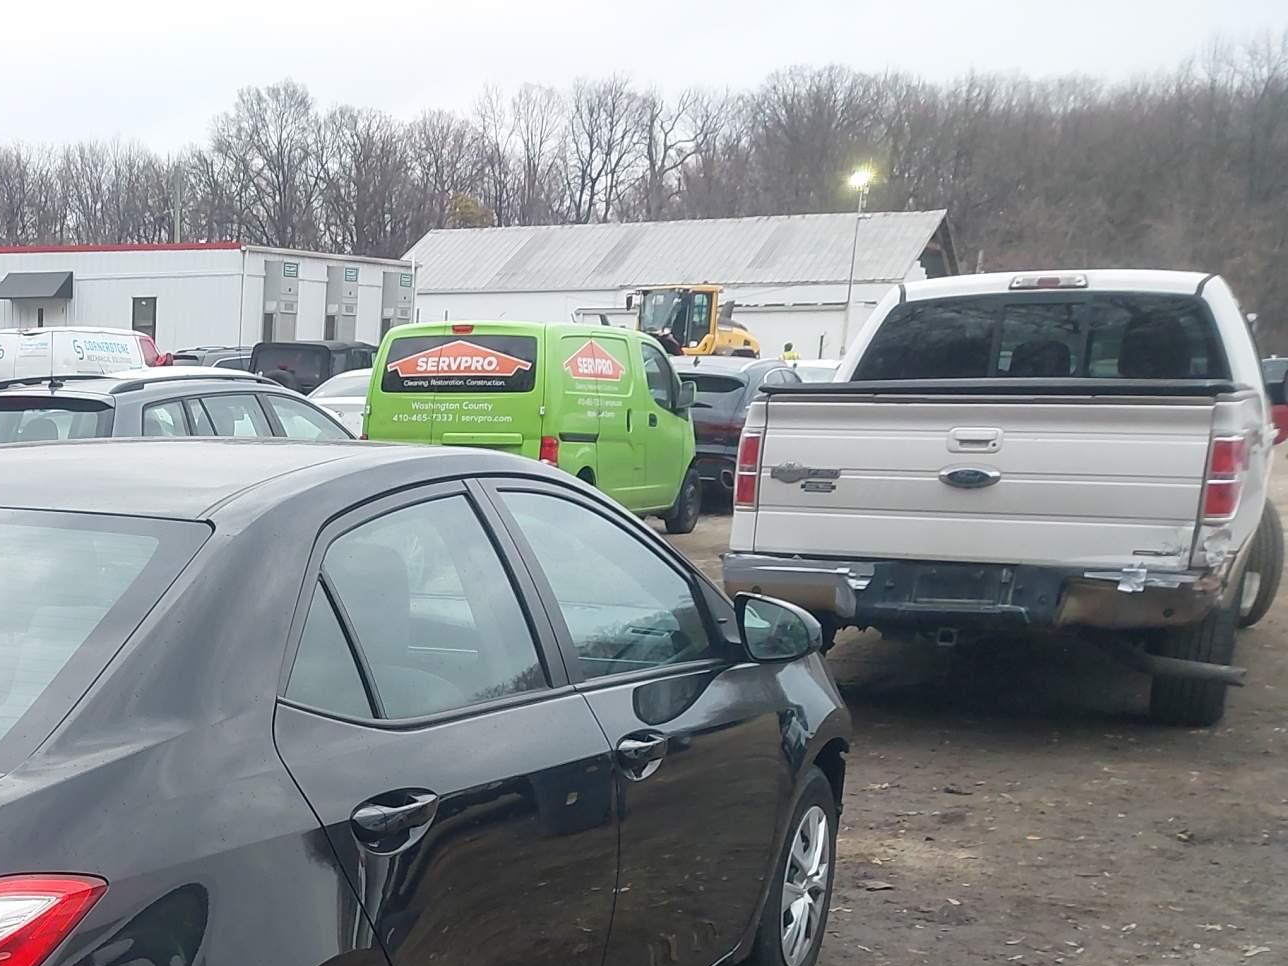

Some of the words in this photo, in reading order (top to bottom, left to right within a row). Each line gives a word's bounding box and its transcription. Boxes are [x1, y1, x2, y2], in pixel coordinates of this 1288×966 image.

[83, 339, 130, 354] CORNERSTONE
[577, 357, 613, 375] SERVPRO
[403, 379, 429, 387] Cleaning
[411, 402, 460, 411] Washington
[463, 402, 493, 412] County
[461, 415, 513, 423] servpro.com
